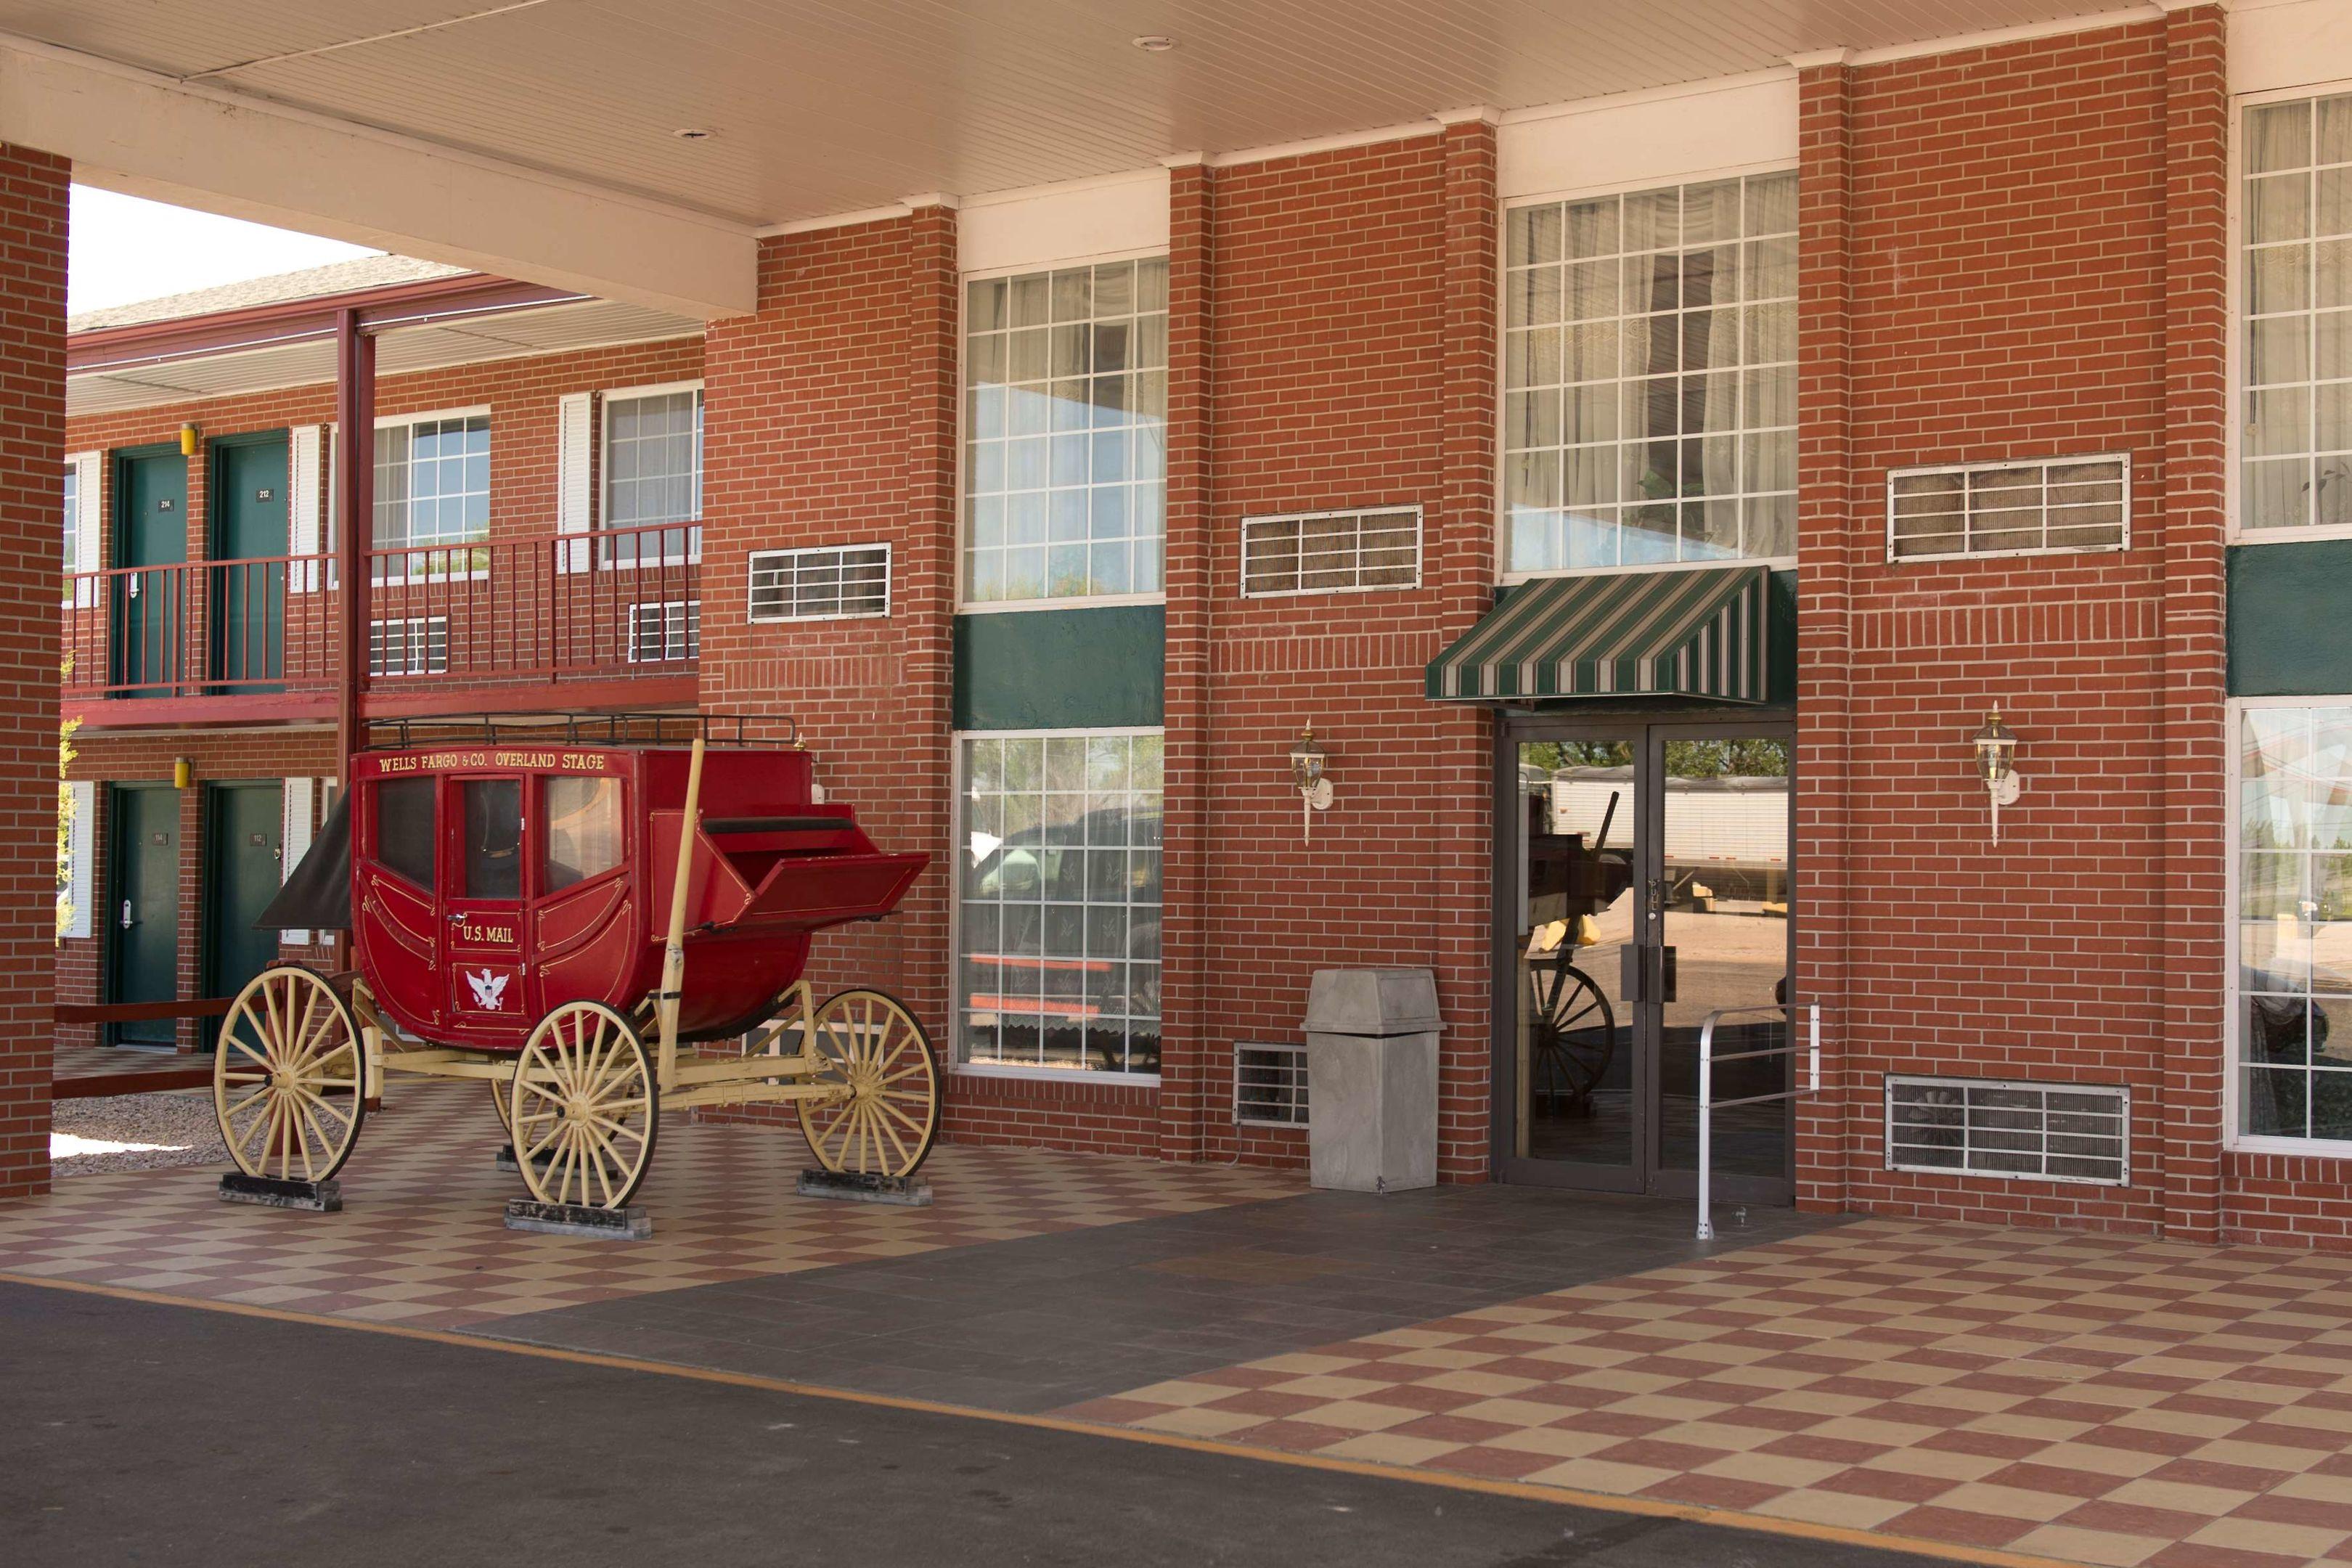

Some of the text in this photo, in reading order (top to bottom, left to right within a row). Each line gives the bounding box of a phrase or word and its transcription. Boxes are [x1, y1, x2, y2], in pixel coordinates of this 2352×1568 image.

[379, 752, 605, 772] WELLS FARGO & CO. OVERLAND STAGE
[463, 926, 514, 943] U.S. MAIL
